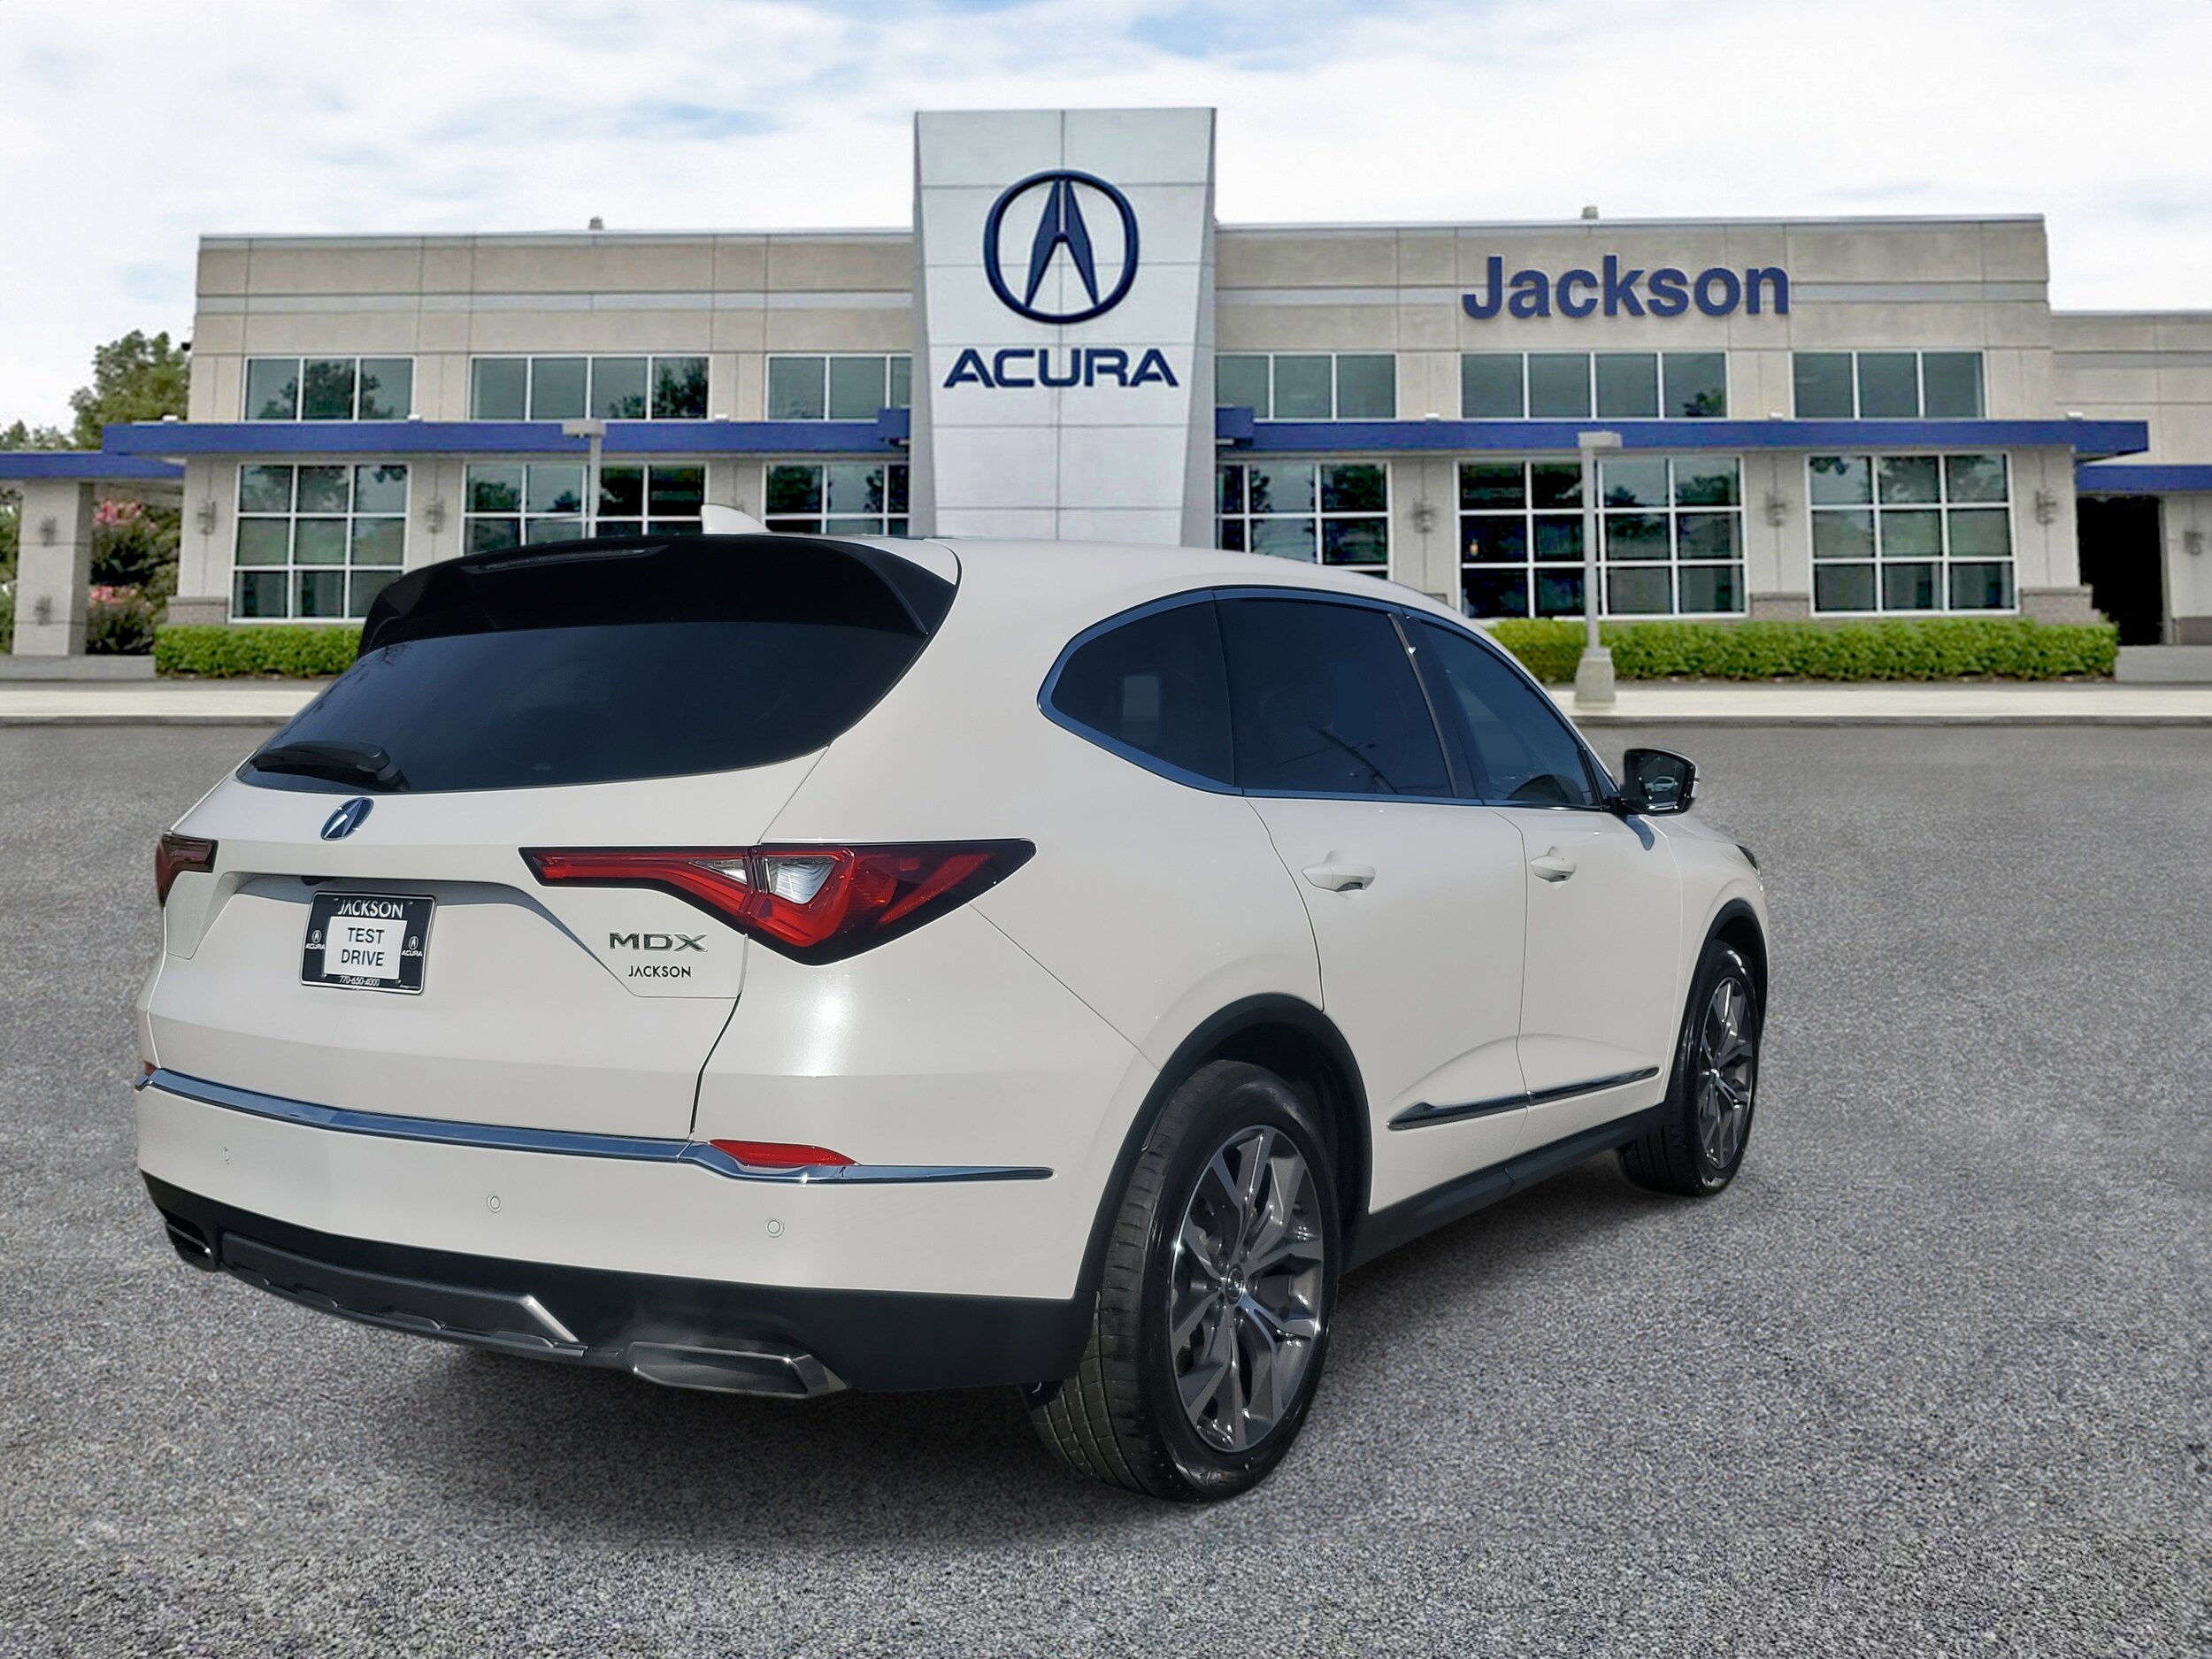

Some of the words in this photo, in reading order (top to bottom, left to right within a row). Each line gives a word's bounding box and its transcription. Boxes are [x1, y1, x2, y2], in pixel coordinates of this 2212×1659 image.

[1462, 255, 1790, 319] Jackson
[943, 349, 1179, 388] ACURA
[338, 899, 403, 919] JACKSON
[348, 927, 385, 944] TEST
[610, 932, 709, 953] MDX
[341, 949, 385, 966] DRIVE
[628, 965, 691, 978] JACKSON
[339, 975, 380, 987] 770-650-4000
